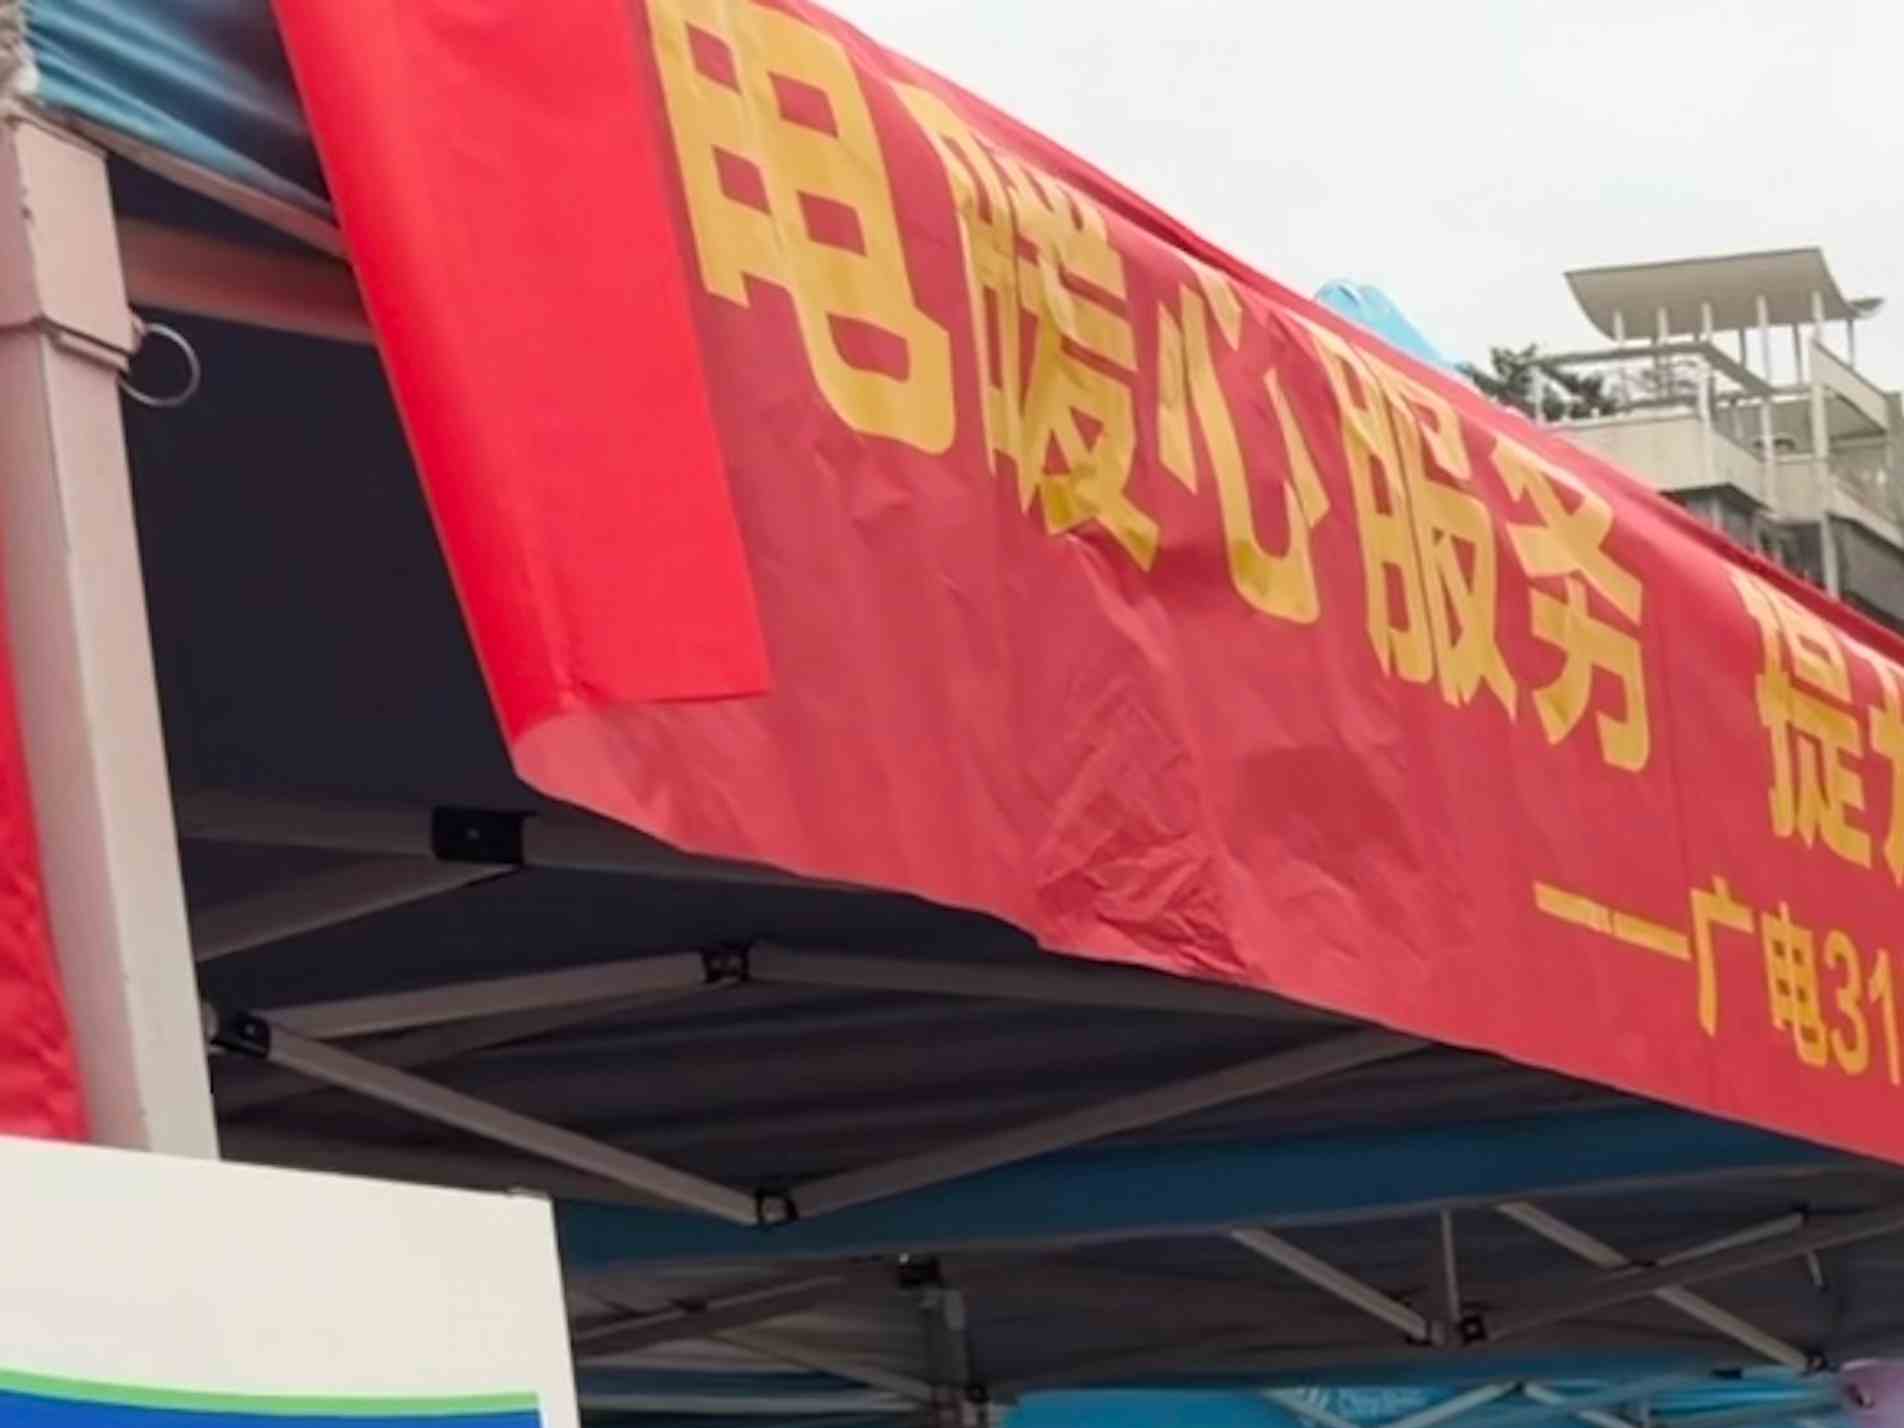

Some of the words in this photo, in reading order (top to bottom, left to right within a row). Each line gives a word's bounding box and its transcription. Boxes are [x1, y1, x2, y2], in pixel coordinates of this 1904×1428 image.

[646, 0, 1651, 772] 电暖心服务
